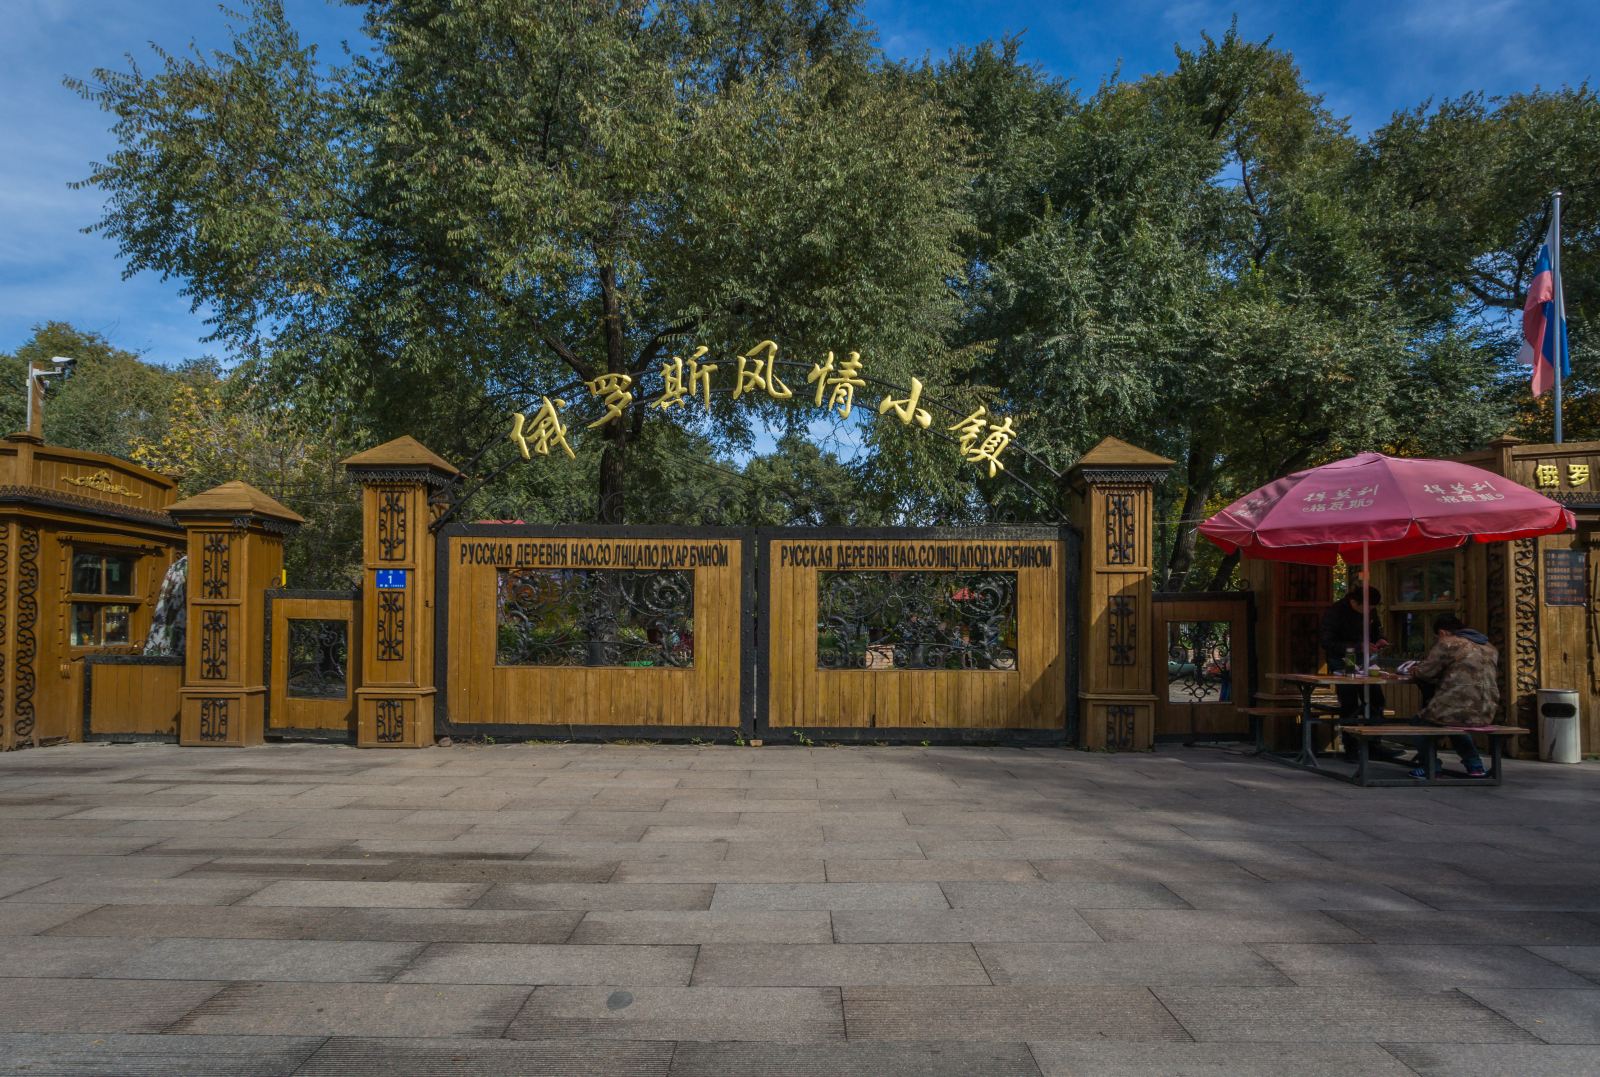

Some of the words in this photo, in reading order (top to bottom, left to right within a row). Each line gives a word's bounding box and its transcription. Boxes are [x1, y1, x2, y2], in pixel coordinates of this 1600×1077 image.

[1536, 464, 1590, 487] 俄罗
[460, 543, 512, 565] РУССКАЯ
[515, 543, 568, 567] ДЕРЕВНЯ
[781, 544, 833, 567] РУССКАЯ
[837, 545, 889, 570] ДЕРЕВНЯ
[387, 575, 393, 584] 1
